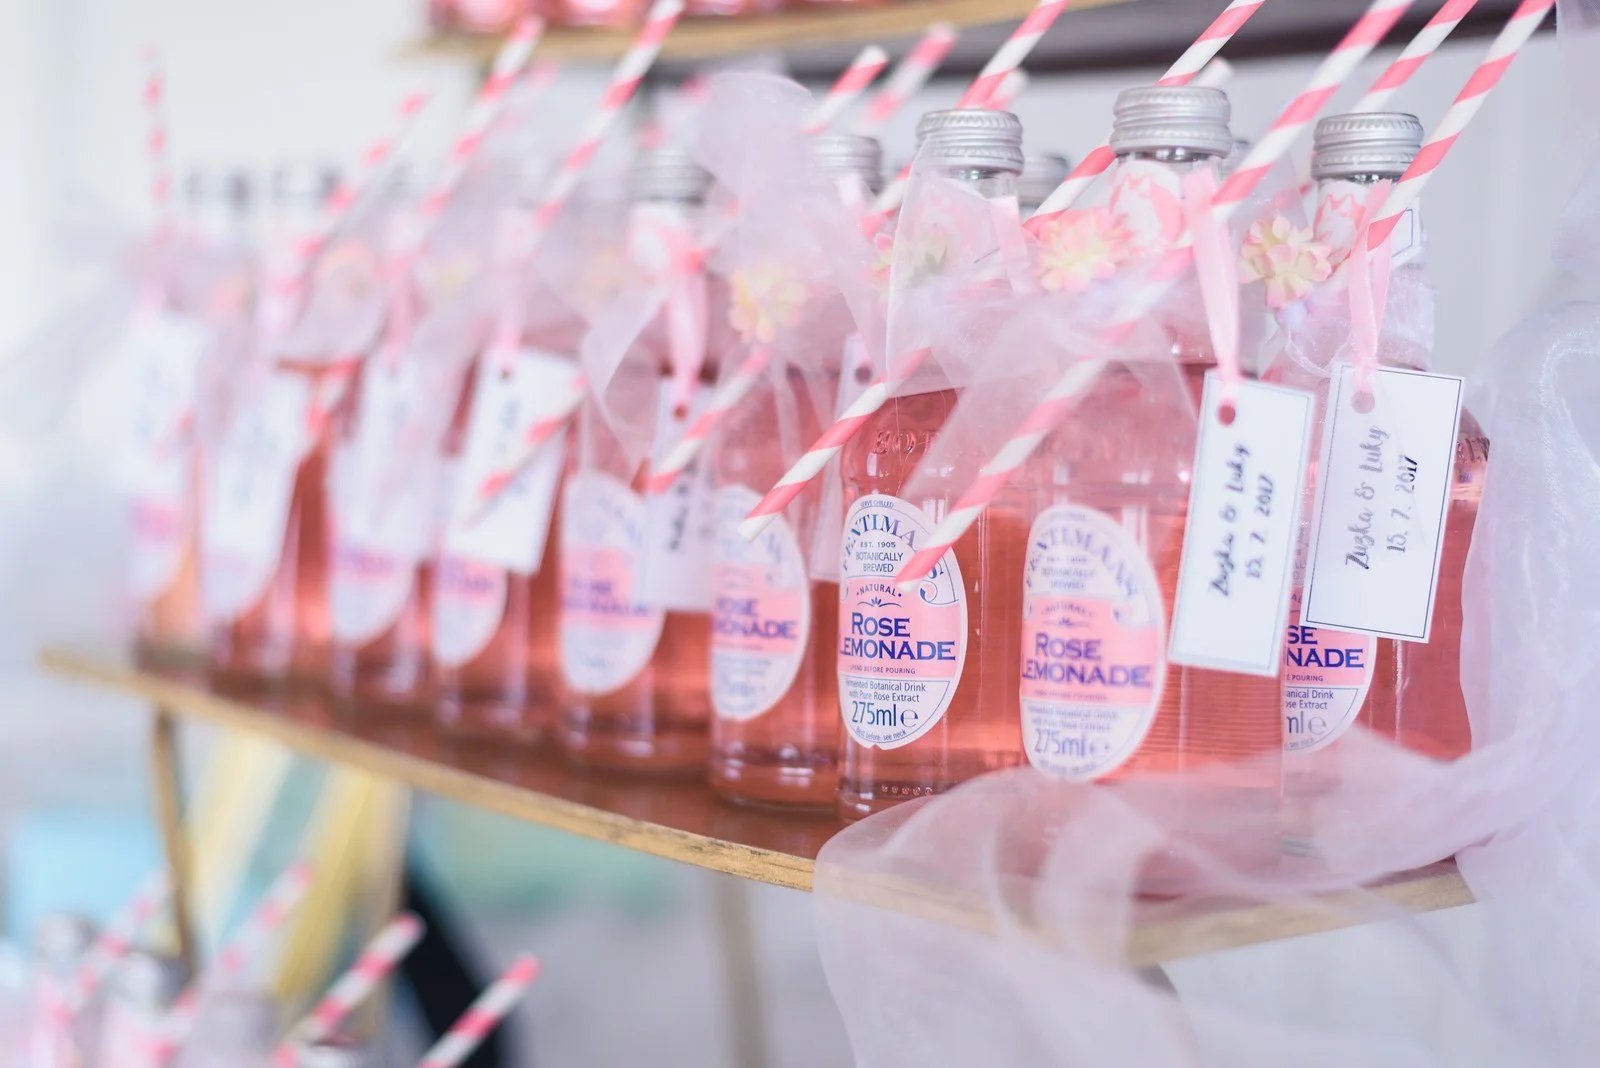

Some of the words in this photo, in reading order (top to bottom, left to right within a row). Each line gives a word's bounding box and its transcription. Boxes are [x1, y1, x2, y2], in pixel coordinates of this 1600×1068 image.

[1359, 426, 1390, 473] Luky
[1394, 454, 1418, 495] 2017
[1254, 473, 1274, 517] 2017
[1386, 530, 1409, 552] 15.
[855, 552, 904, 561] BOTANICALLY
[862, 563, 894, 573] BREWED
[1035, 632, 1103, 661] ROSE
[1292, 674, 1324, 682] POURING
[869, 681, 902, 691] Botanical
[904, 682, 926, 692] Drink
[873, 691, 890, 701] Rose
[892, 692, 920, 702] Extract
[1312, 689, 1334, 699] Drink
[1299, 700, 1328, 709] Extract
